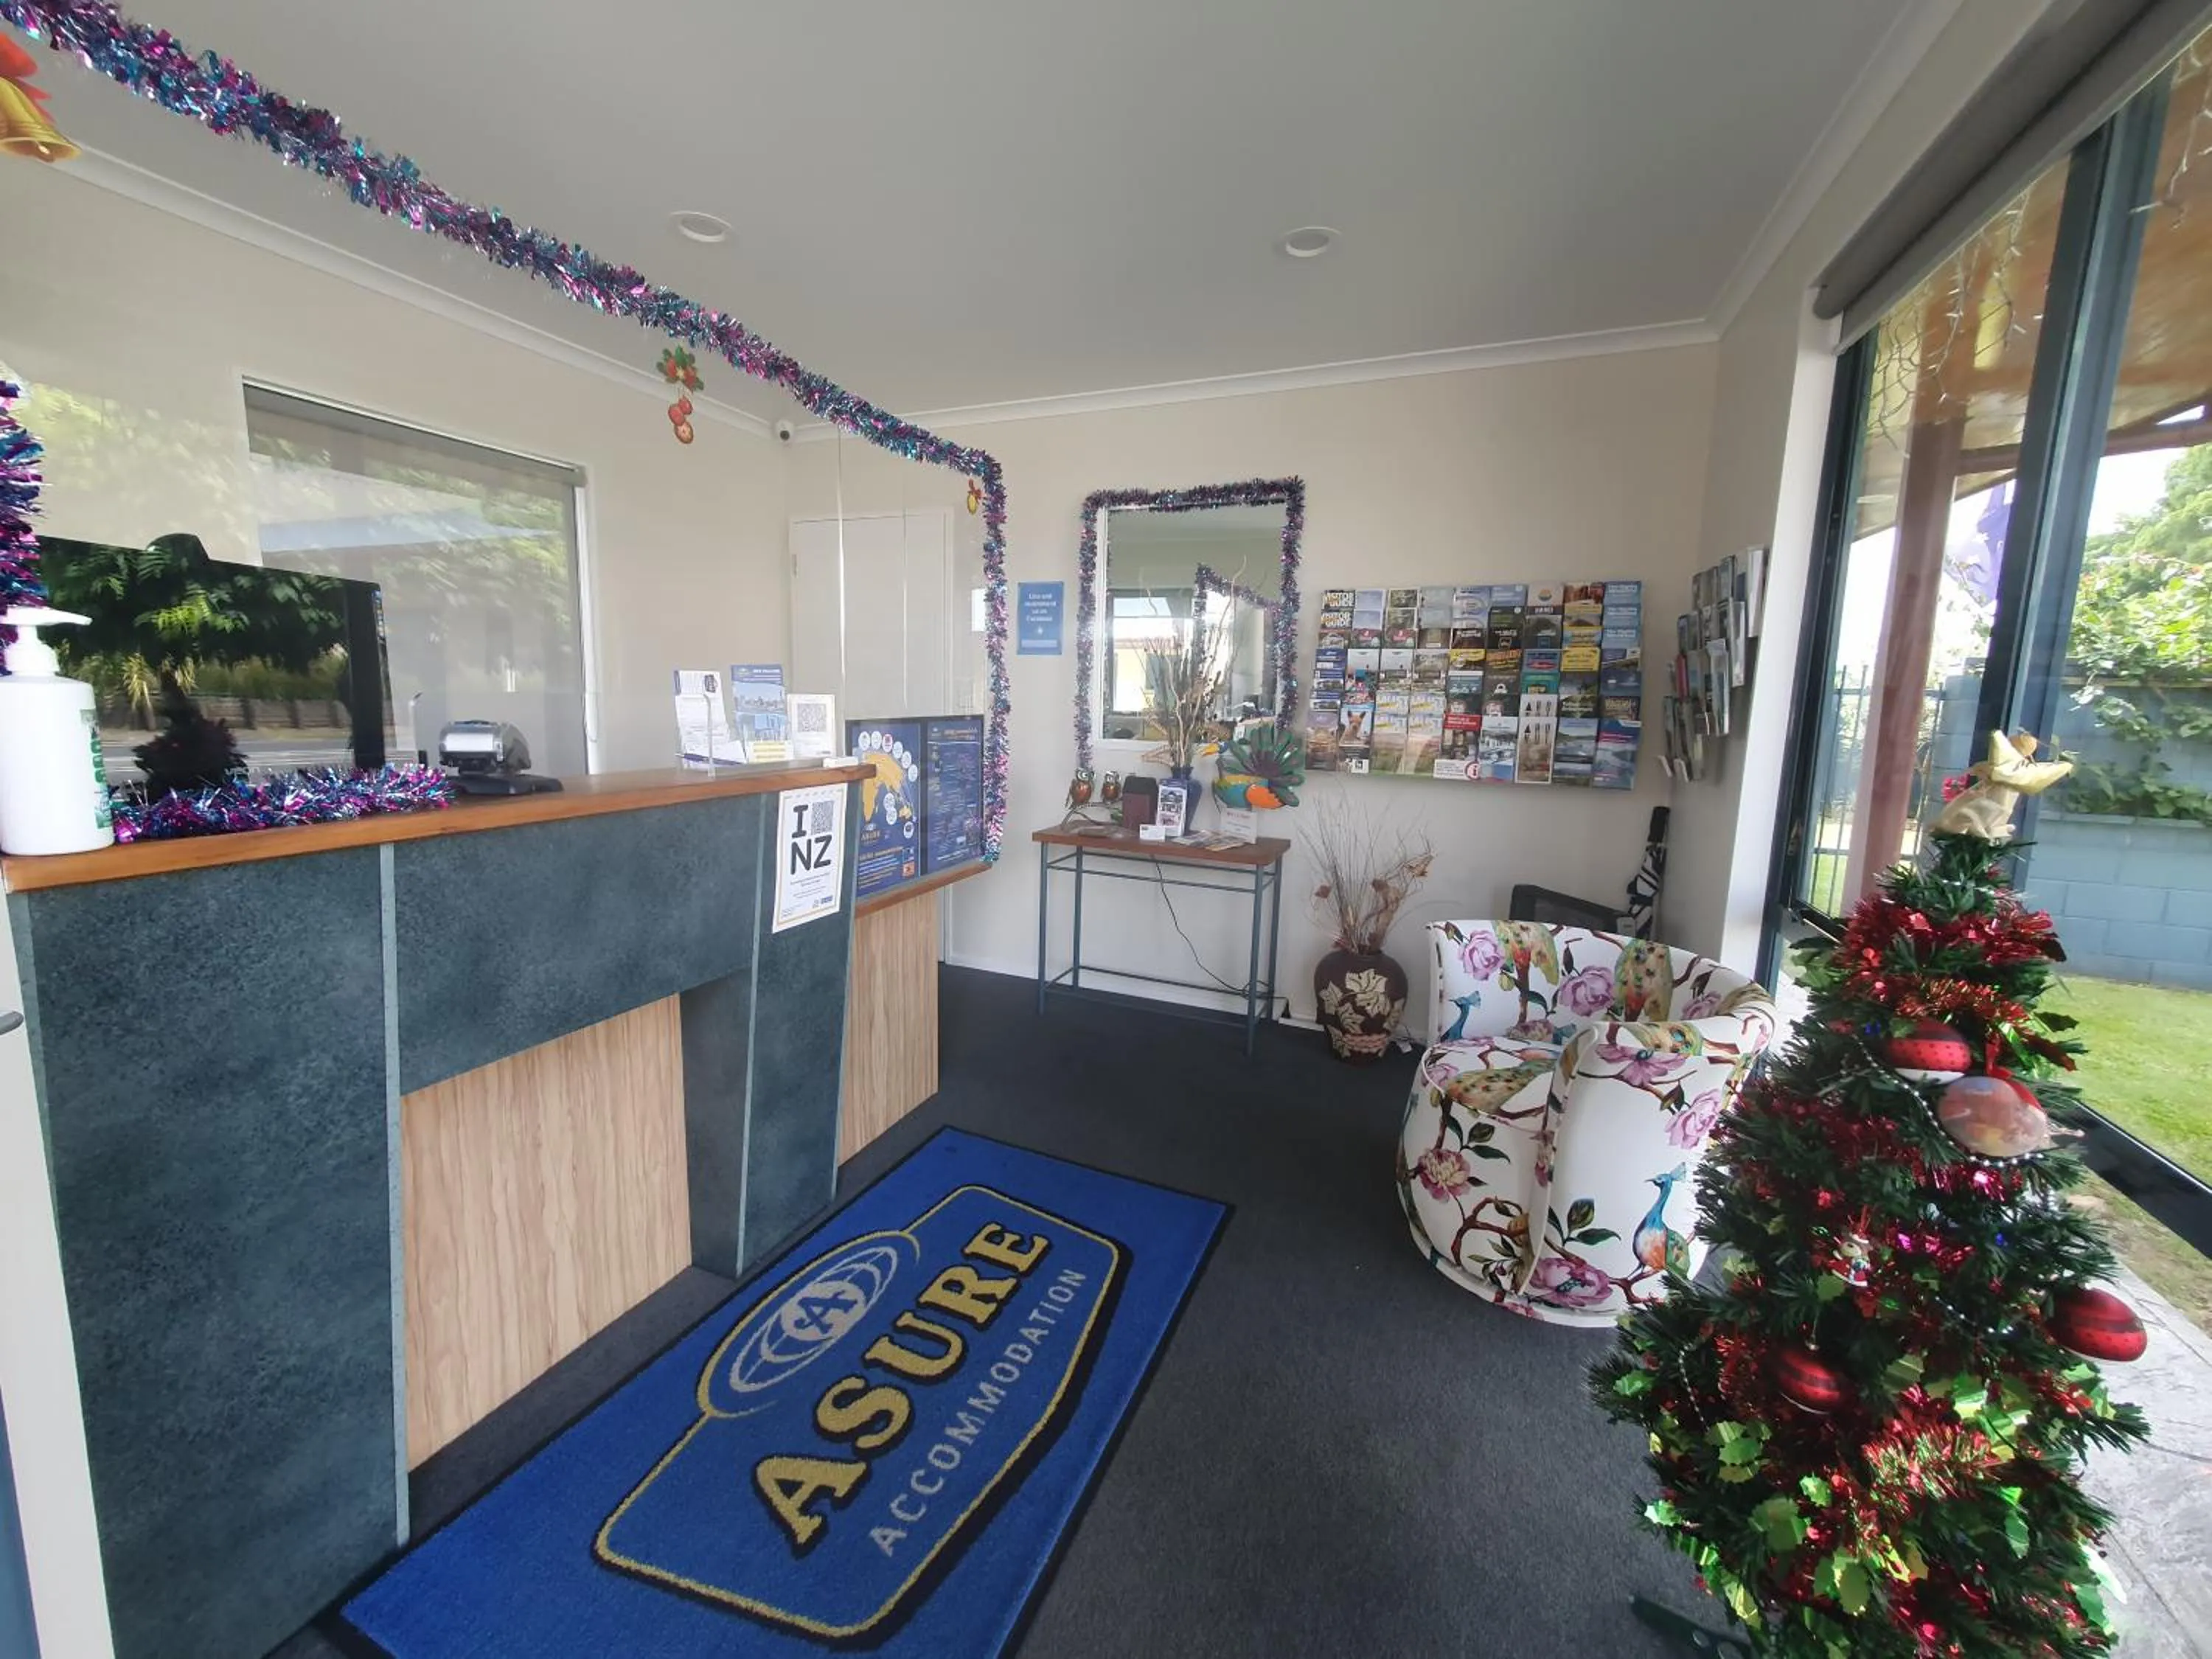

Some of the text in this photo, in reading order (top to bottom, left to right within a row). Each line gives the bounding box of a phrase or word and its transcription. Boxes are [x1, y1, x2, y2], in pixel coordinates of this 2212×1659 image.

[790, 835, 832, 875] NZ
[791, 804, 809, 838] I
[755, 1222, 1051, 1545] ASURE
[870, 1267, 1086, 1557] ACCOMMODATION
